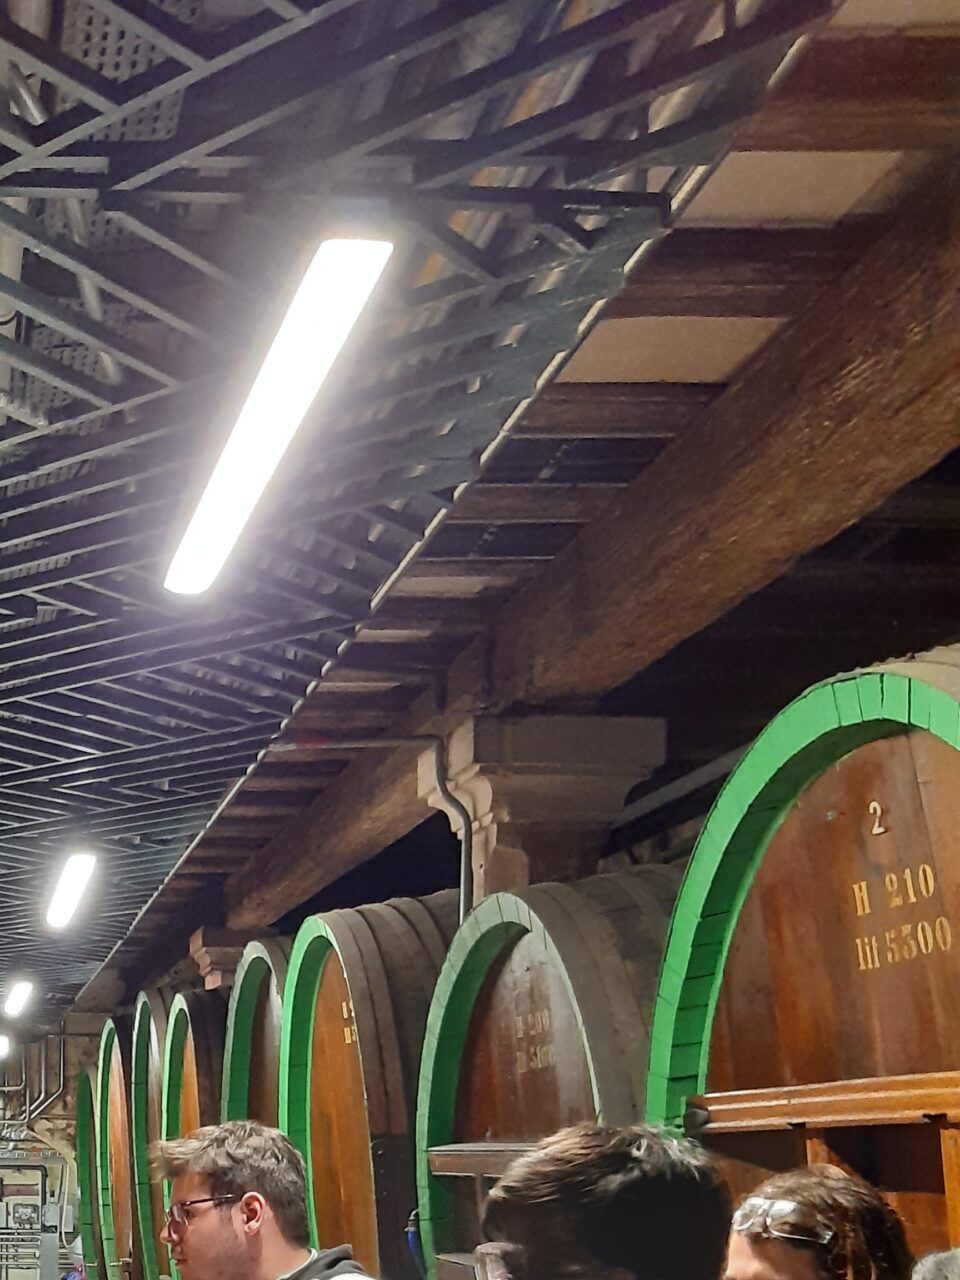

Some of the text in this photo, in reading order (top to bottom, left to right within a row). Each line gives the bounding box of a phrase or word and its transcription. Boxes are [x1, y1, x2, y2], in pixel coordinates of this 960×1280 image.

[868, 800, 886, 835] 2
[852, 863, 935, 916] H 210
